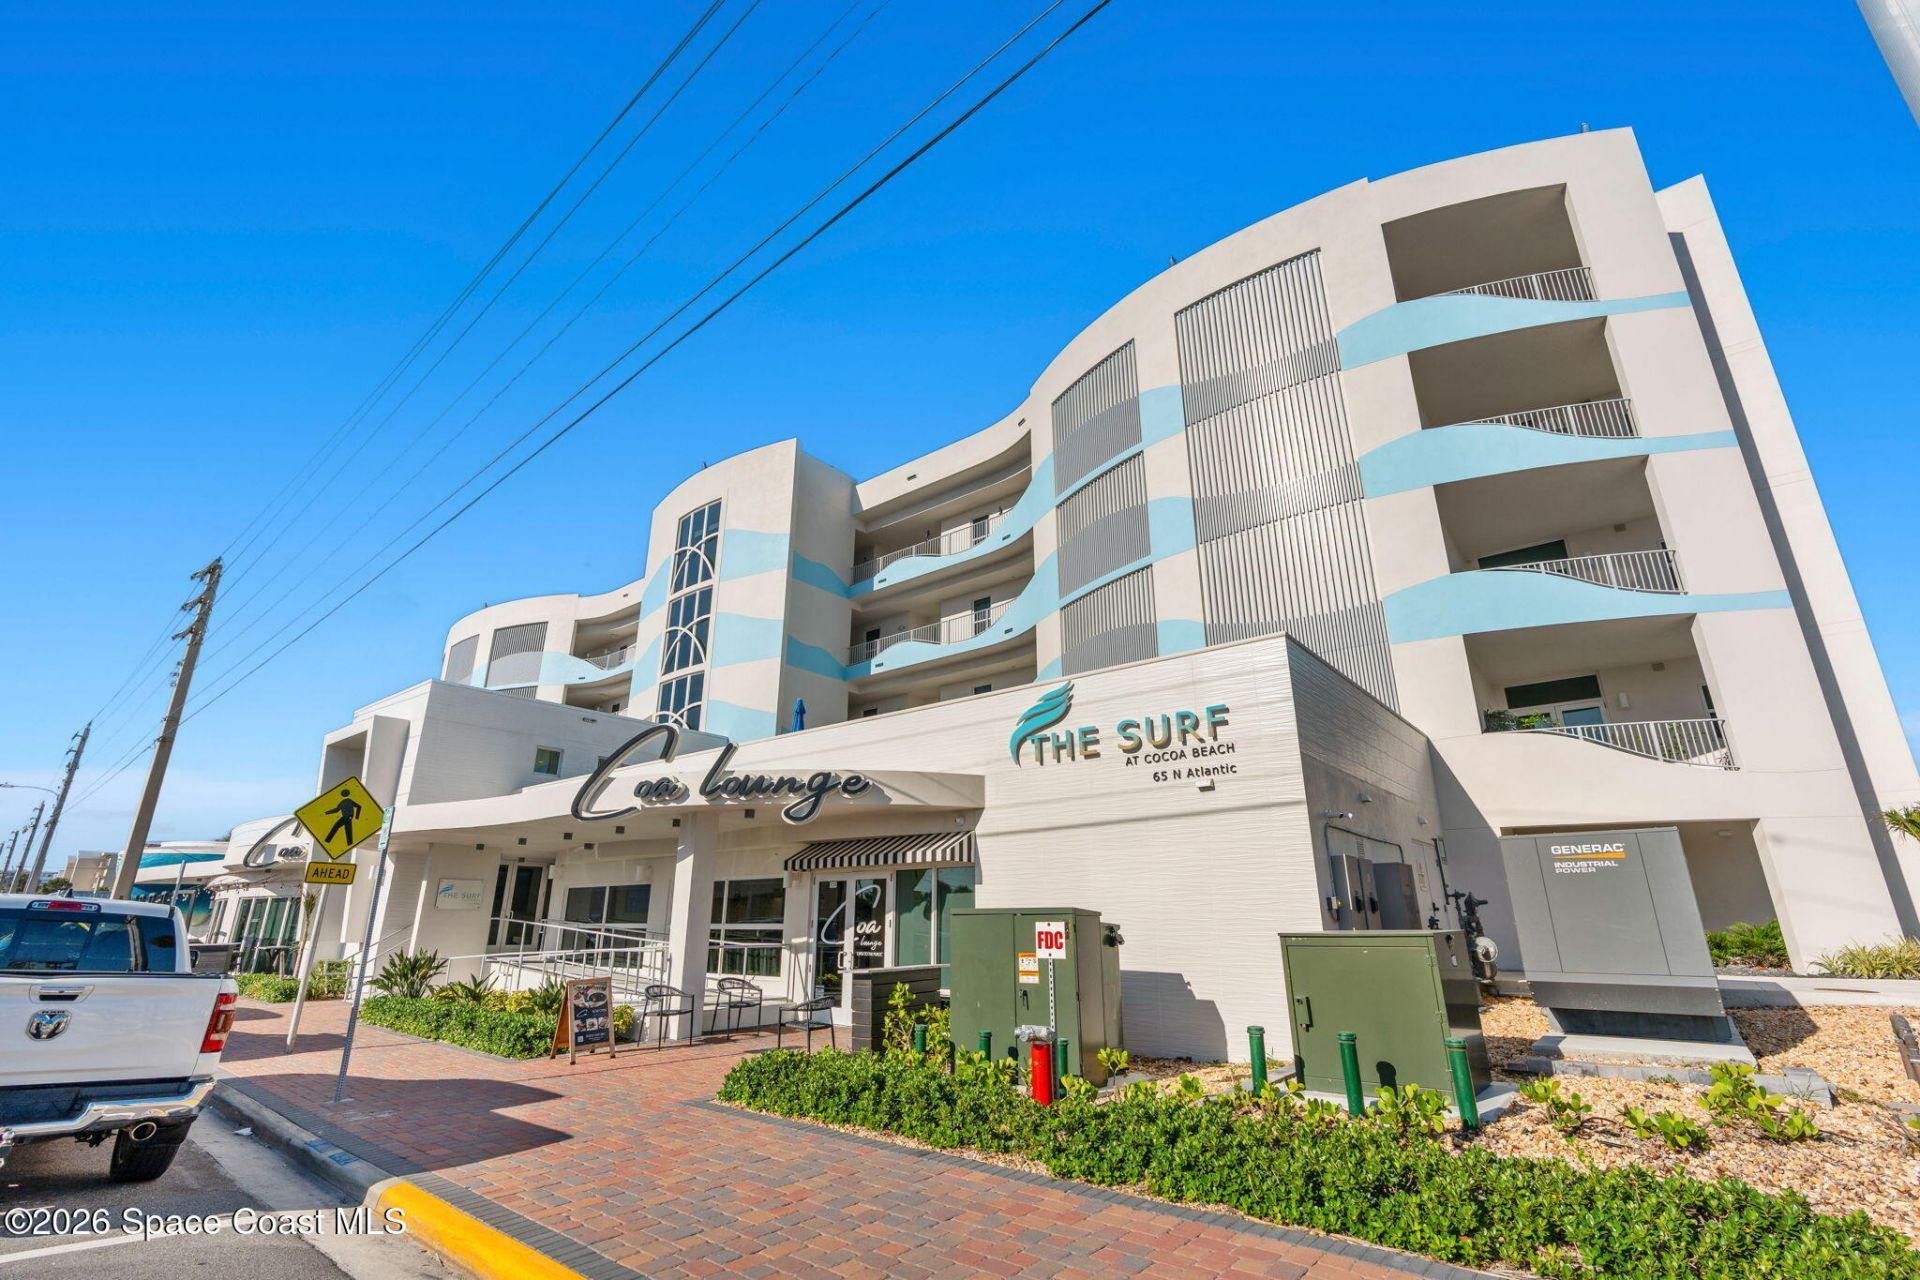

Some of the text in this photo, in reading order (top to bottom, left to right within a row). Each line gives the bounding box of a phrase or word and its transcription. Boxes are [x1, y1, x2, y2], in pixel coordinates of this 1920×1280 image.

[1027, 704, 1229, 766] THE SURF
[1125, 742, 1236, 767] AT COCOA BEACH
[571, 723, 875, 824] Coa lounge
[1152, 763, 1238, 782] 65 N Atlantic
[1550, 843, 1625, 855] GENERAC
[311, 867, 351, 880] AHEAD
[1553, 860, 1619, 869] INDUSTRIAL
[820, 884, 882, 945] Coa
[1037, 930, 1064, 950] FDC
